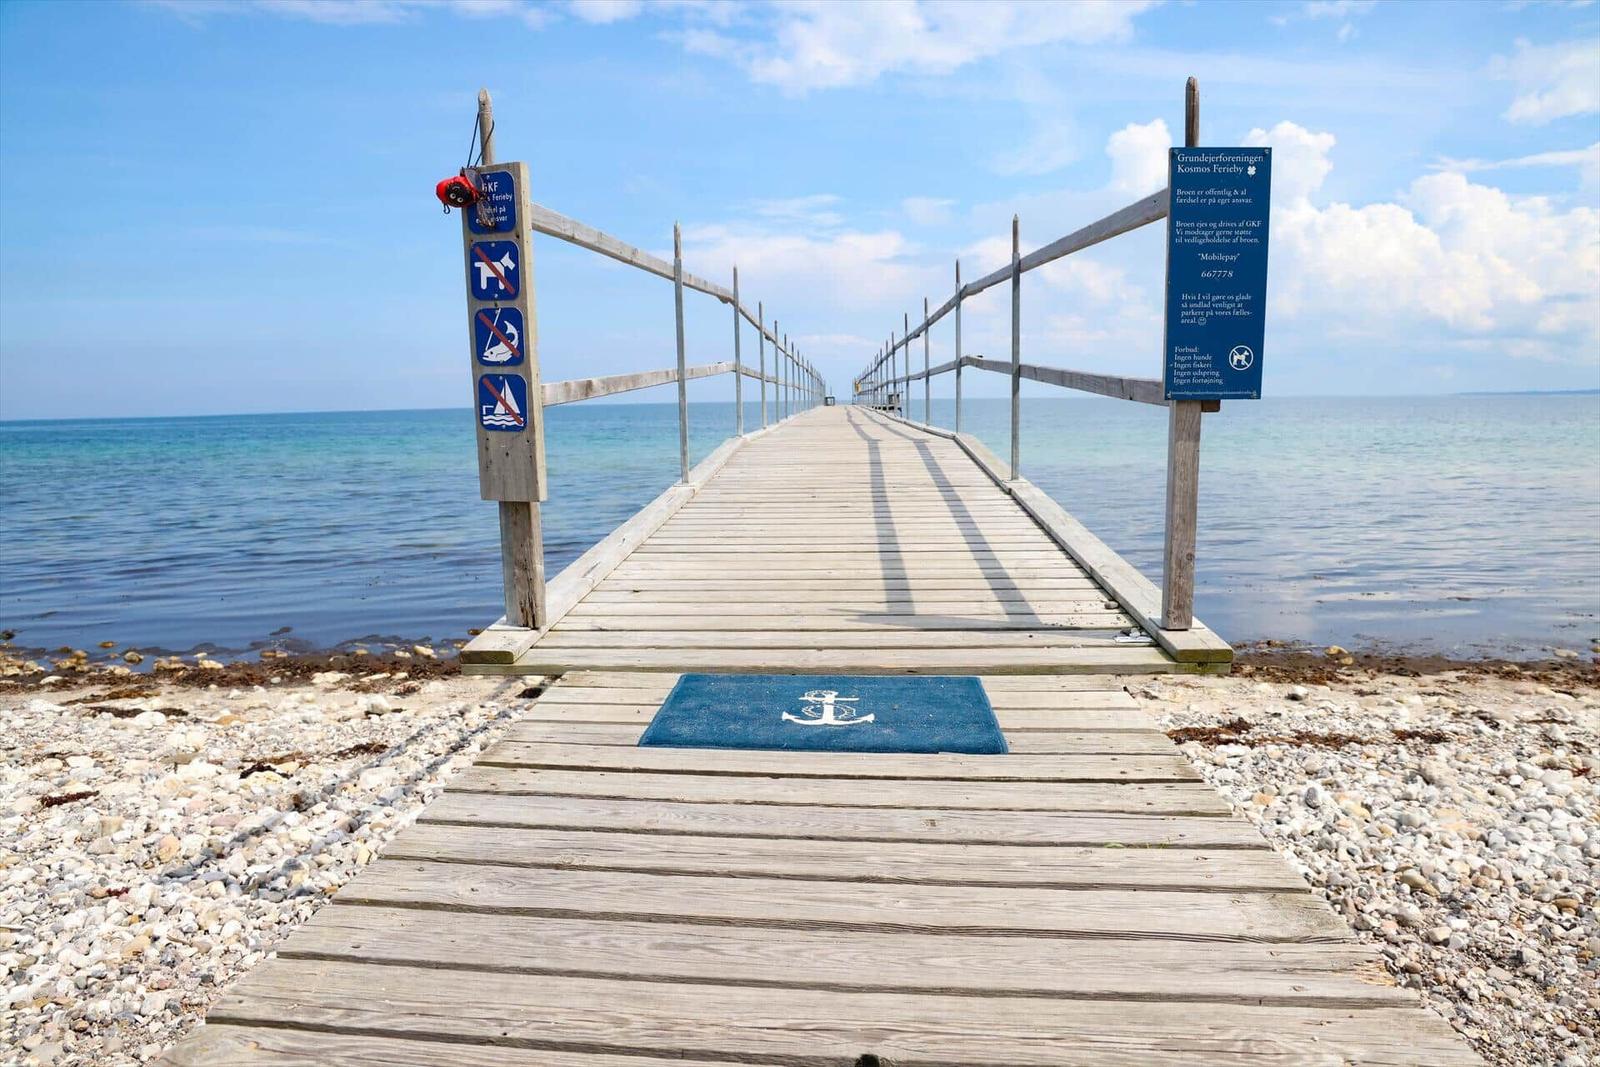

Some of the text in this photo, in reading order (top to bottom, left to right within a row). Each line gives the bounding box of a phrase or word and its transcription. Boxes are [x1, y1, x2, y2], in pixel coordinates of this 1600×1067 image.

[1177, 153, 1264, 165] Grundejerforeningen
[1177, 164, 1244, 174] Kosmos Ferieby
[492, 192, 513, 202] Ferieby
[1176, 188, 1196, 196] Broen
[1205, 188, 1232, 197] offentlig
[1176, 196, 1199, 204] færdsel
[1208, 197, 1216, 205] på
[499, 206, 506, 214] på
[1176, 220, 1262, 229] Broen ejes og drives af GKF
[1184, 228, 1215, 237] modtager
[1216, 229, 1233, 237] gerne
[1175, 236, 1183, 244] til
[1184, 236, 1233, 245] vedligeholdelse
[1233, 236, 1240, 244] af
[1201, 270, 1233, 279] 667778
[1235, 293, 1252, 301] glade
[1211, 301, 1236, 309] venligst
[1181, 309, 1205, 318] parkere
[1205, 309, 1214, 318] på
[1193, 353, 1212, 361] hunde
[1192, 361, 1212, 369] fiskeri
[1173, 369, 1220, 377] Ingen udspring
[1173, 377, 1224, 385] Ingen fortøjning
